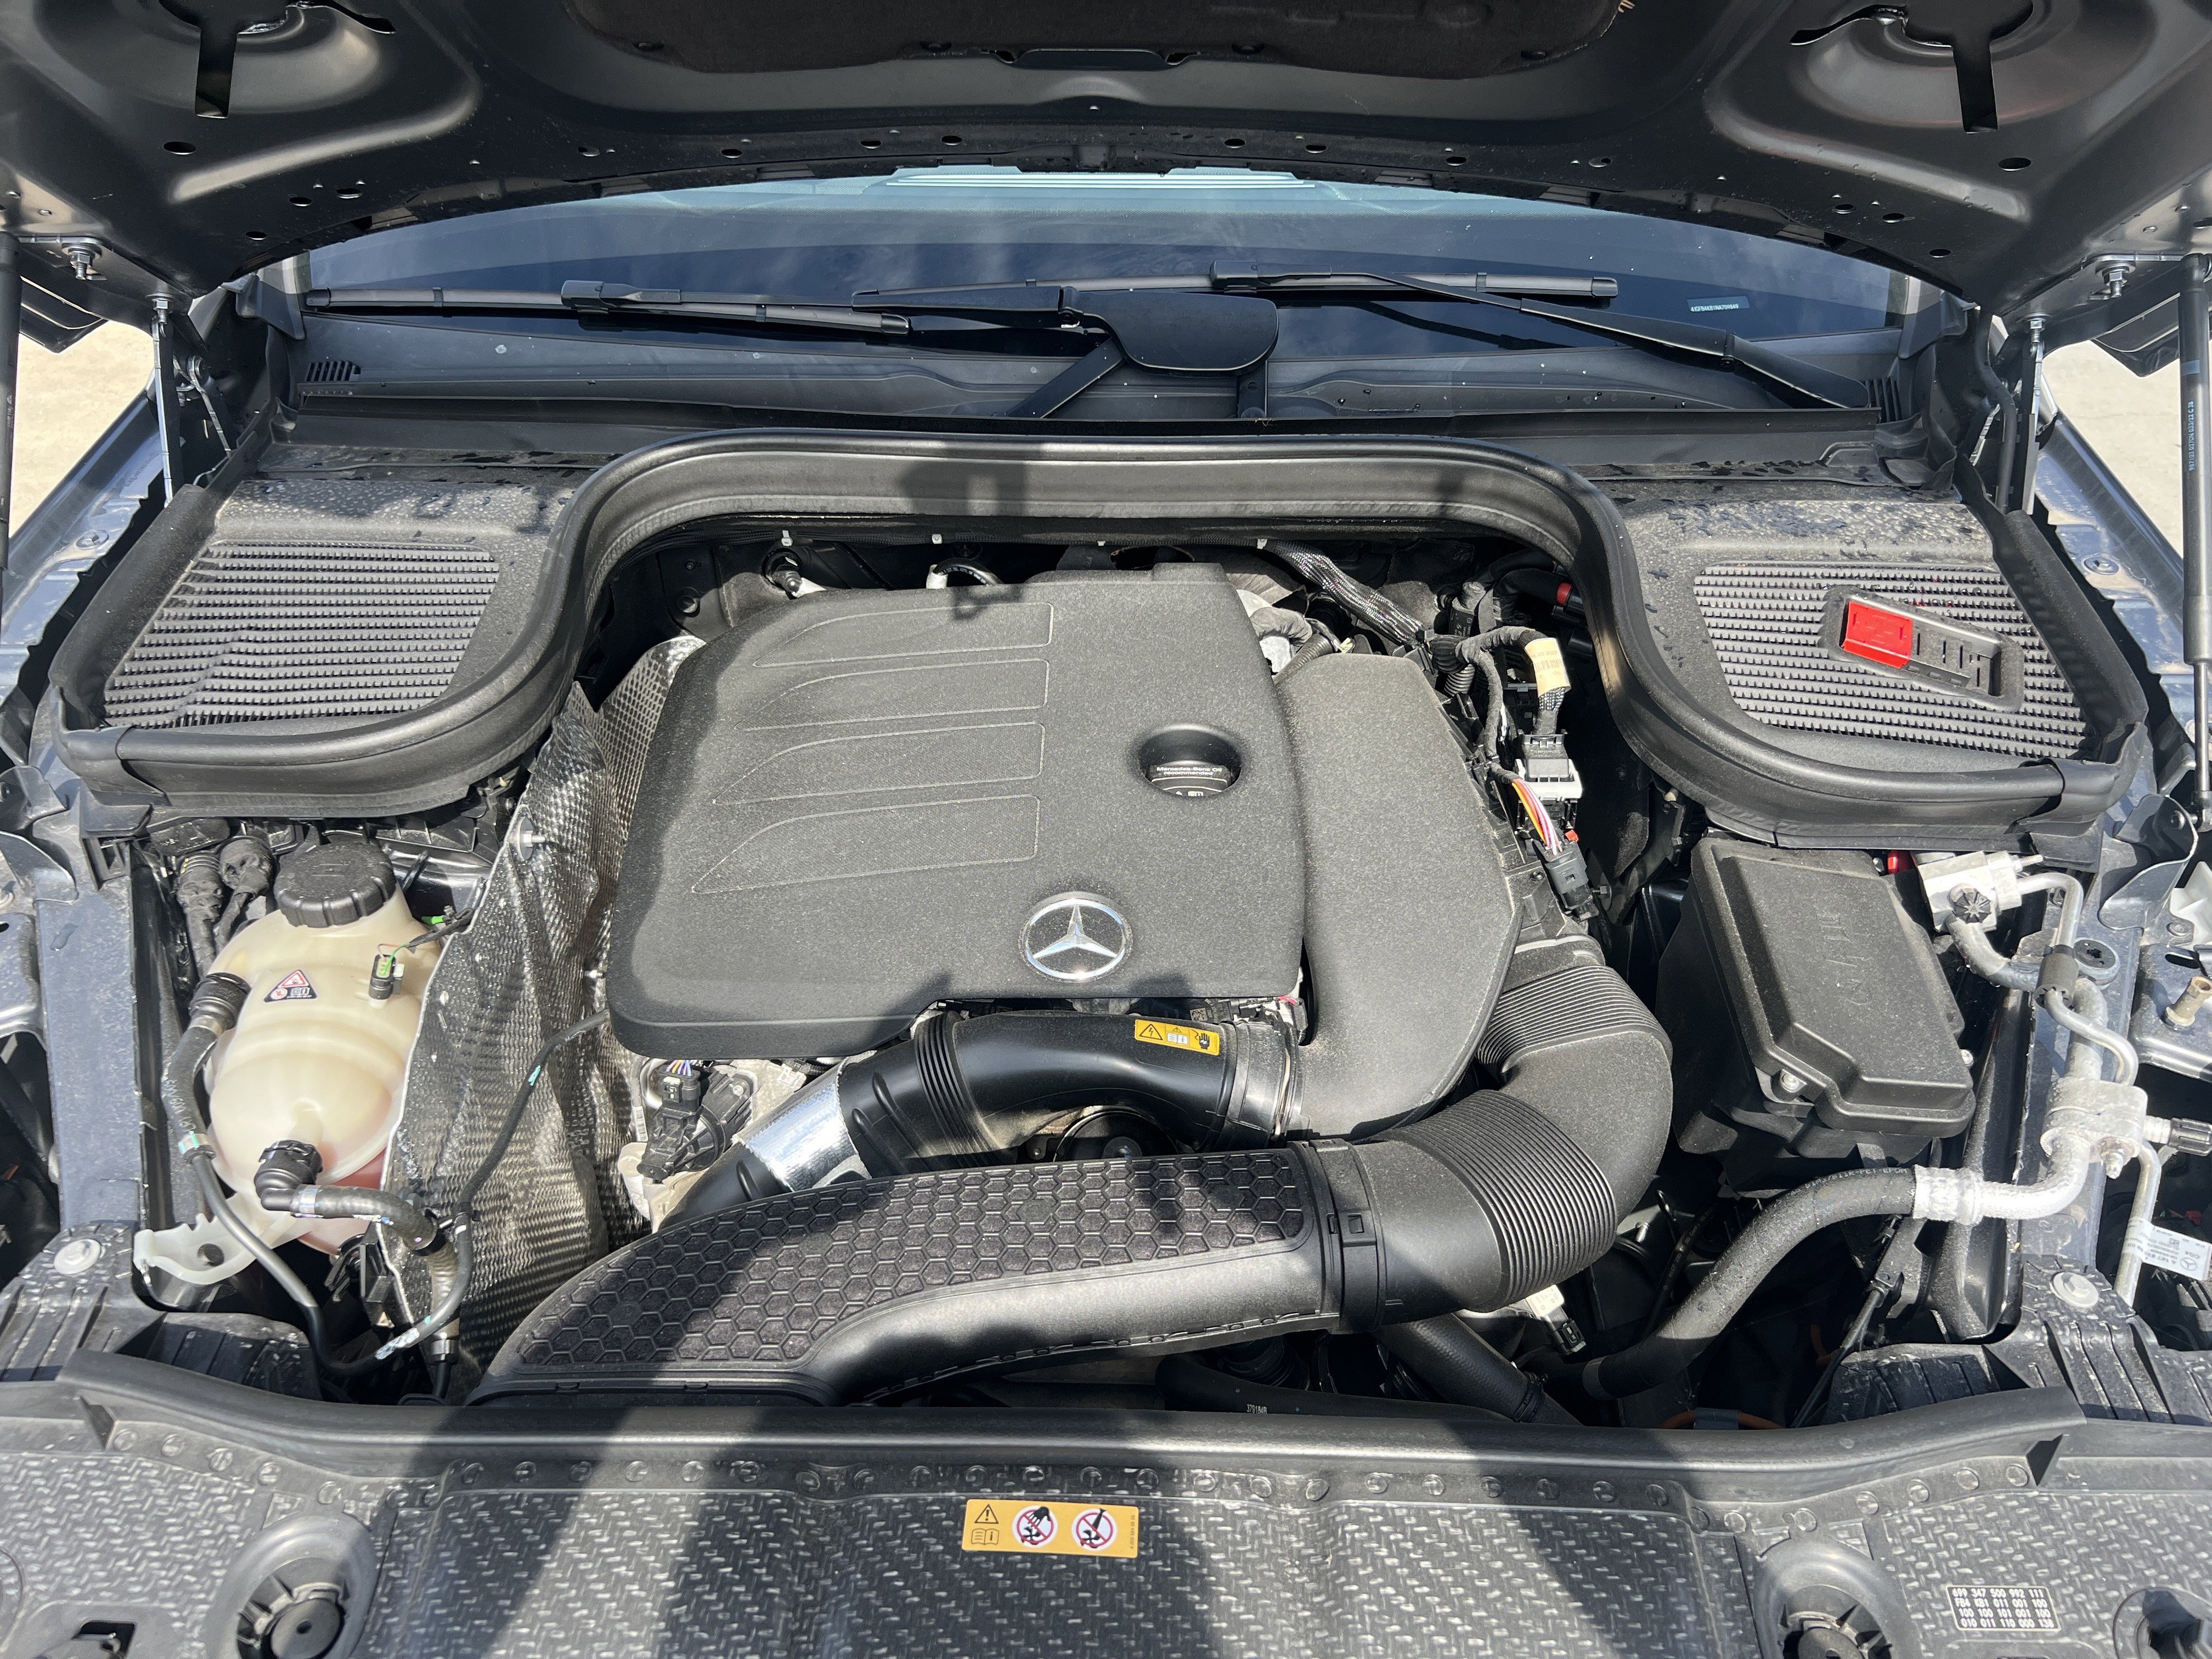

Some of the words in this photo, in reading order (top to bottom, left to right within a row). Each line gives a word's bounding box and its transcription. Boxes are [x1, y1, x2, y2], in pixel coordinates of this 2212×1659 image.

[1952, 1588, 1967, 1598] 699
[1971, 1588, 1986, 1598] 347
[1989, 1588, 2006, 1598] 500
[2008, 1589, 2025, 1598] 992
[2029, 1589, 2044, 1598] 111
[1954, 1598, 1971, 1607] FB4
[1993, 1598, 2008, 1607] 011
[2012, 1598, 2028, 1607] 001
[2032, 1598, 2047, 1607] 100
[1959, 1608, 1974, 1618] 100
[1977, 1608, 1994, 1618] 100
[1997, 1608, 2012, 1618] 101
[2015, 1608, 2031, 1618] 001
[2035, 1608, 2051, 1618] 100
[1960, 1618, 1977, 1628] 010
[1980, 1618, 1996, 1628] 011
[2000, 1618, 2016, 1628] 110
[2018, 1618, 2035, 1628] 000
